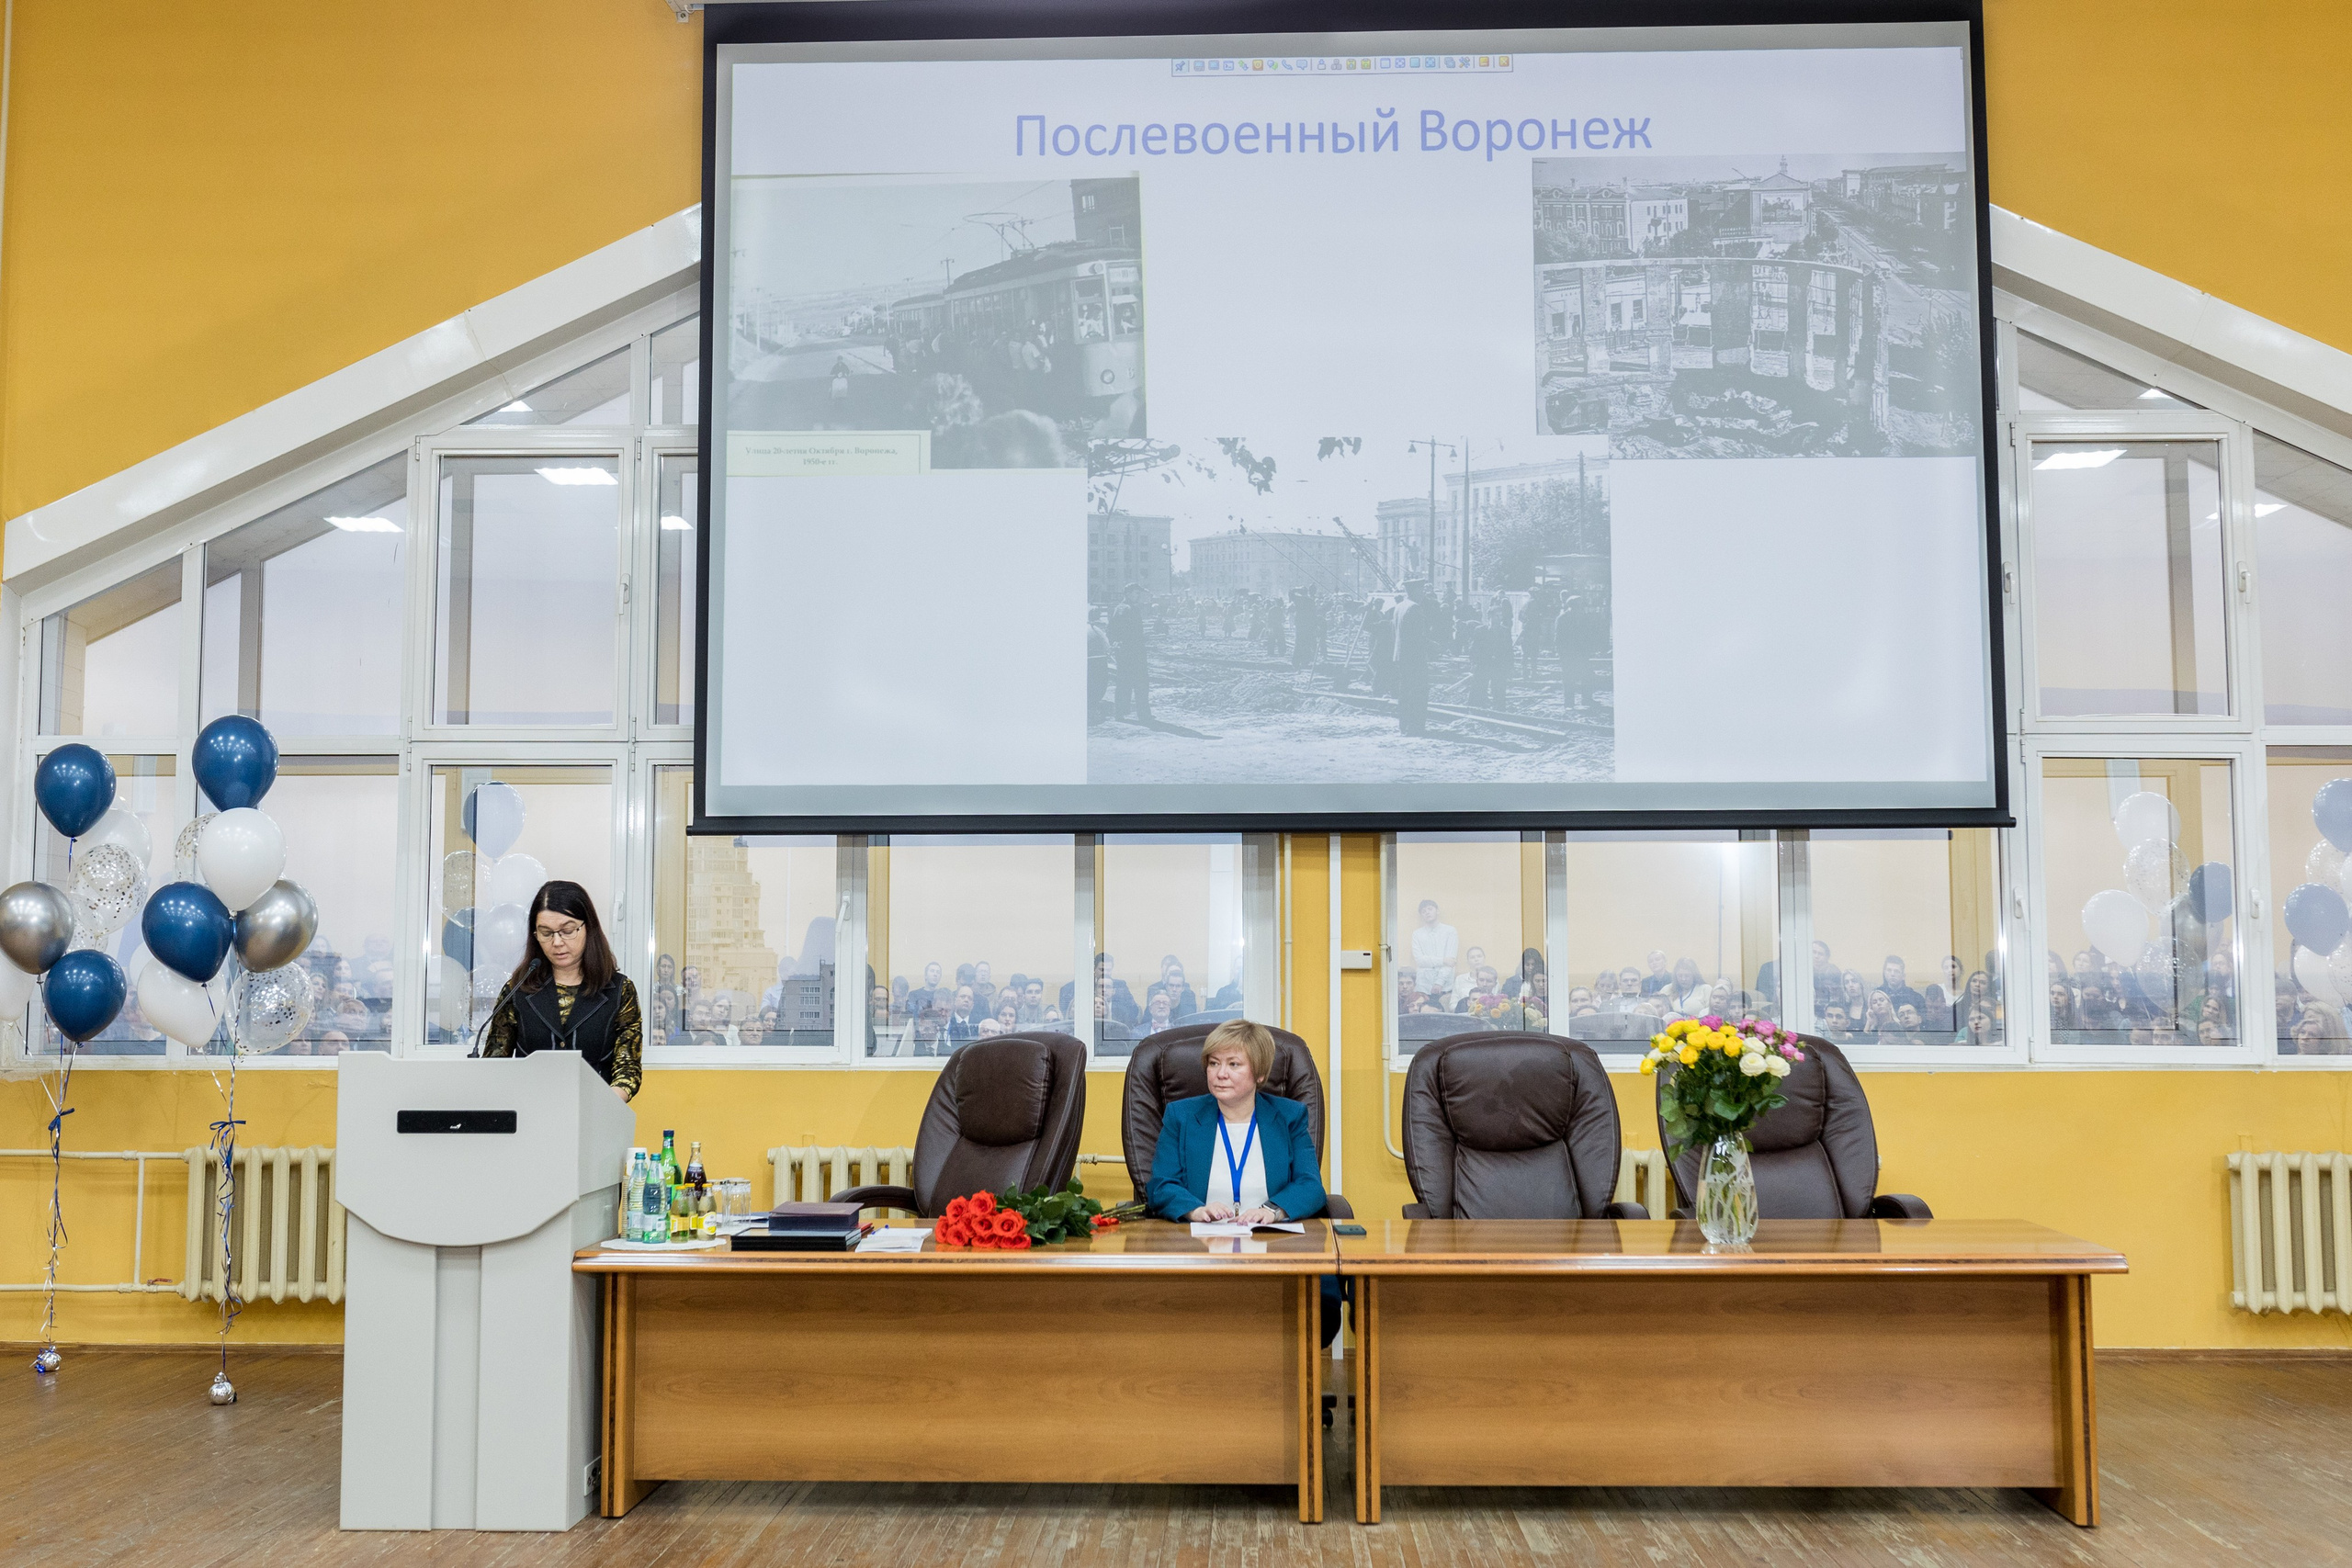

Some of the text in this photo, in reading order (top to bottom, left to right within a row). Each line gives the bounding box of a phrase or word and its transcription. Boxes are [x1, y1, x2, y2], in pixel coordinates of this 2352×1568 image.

[1015, 107, 1654, 162] Послевоенный Воронеж
[745, 446, 771, 455] Улица
[773, 446, 808, 455] 20-летия
[808, 446, 844, 456] Октября
[854, 446, 898, 456] Воронежа,
[803, 457, 827, 466] 1950-е
